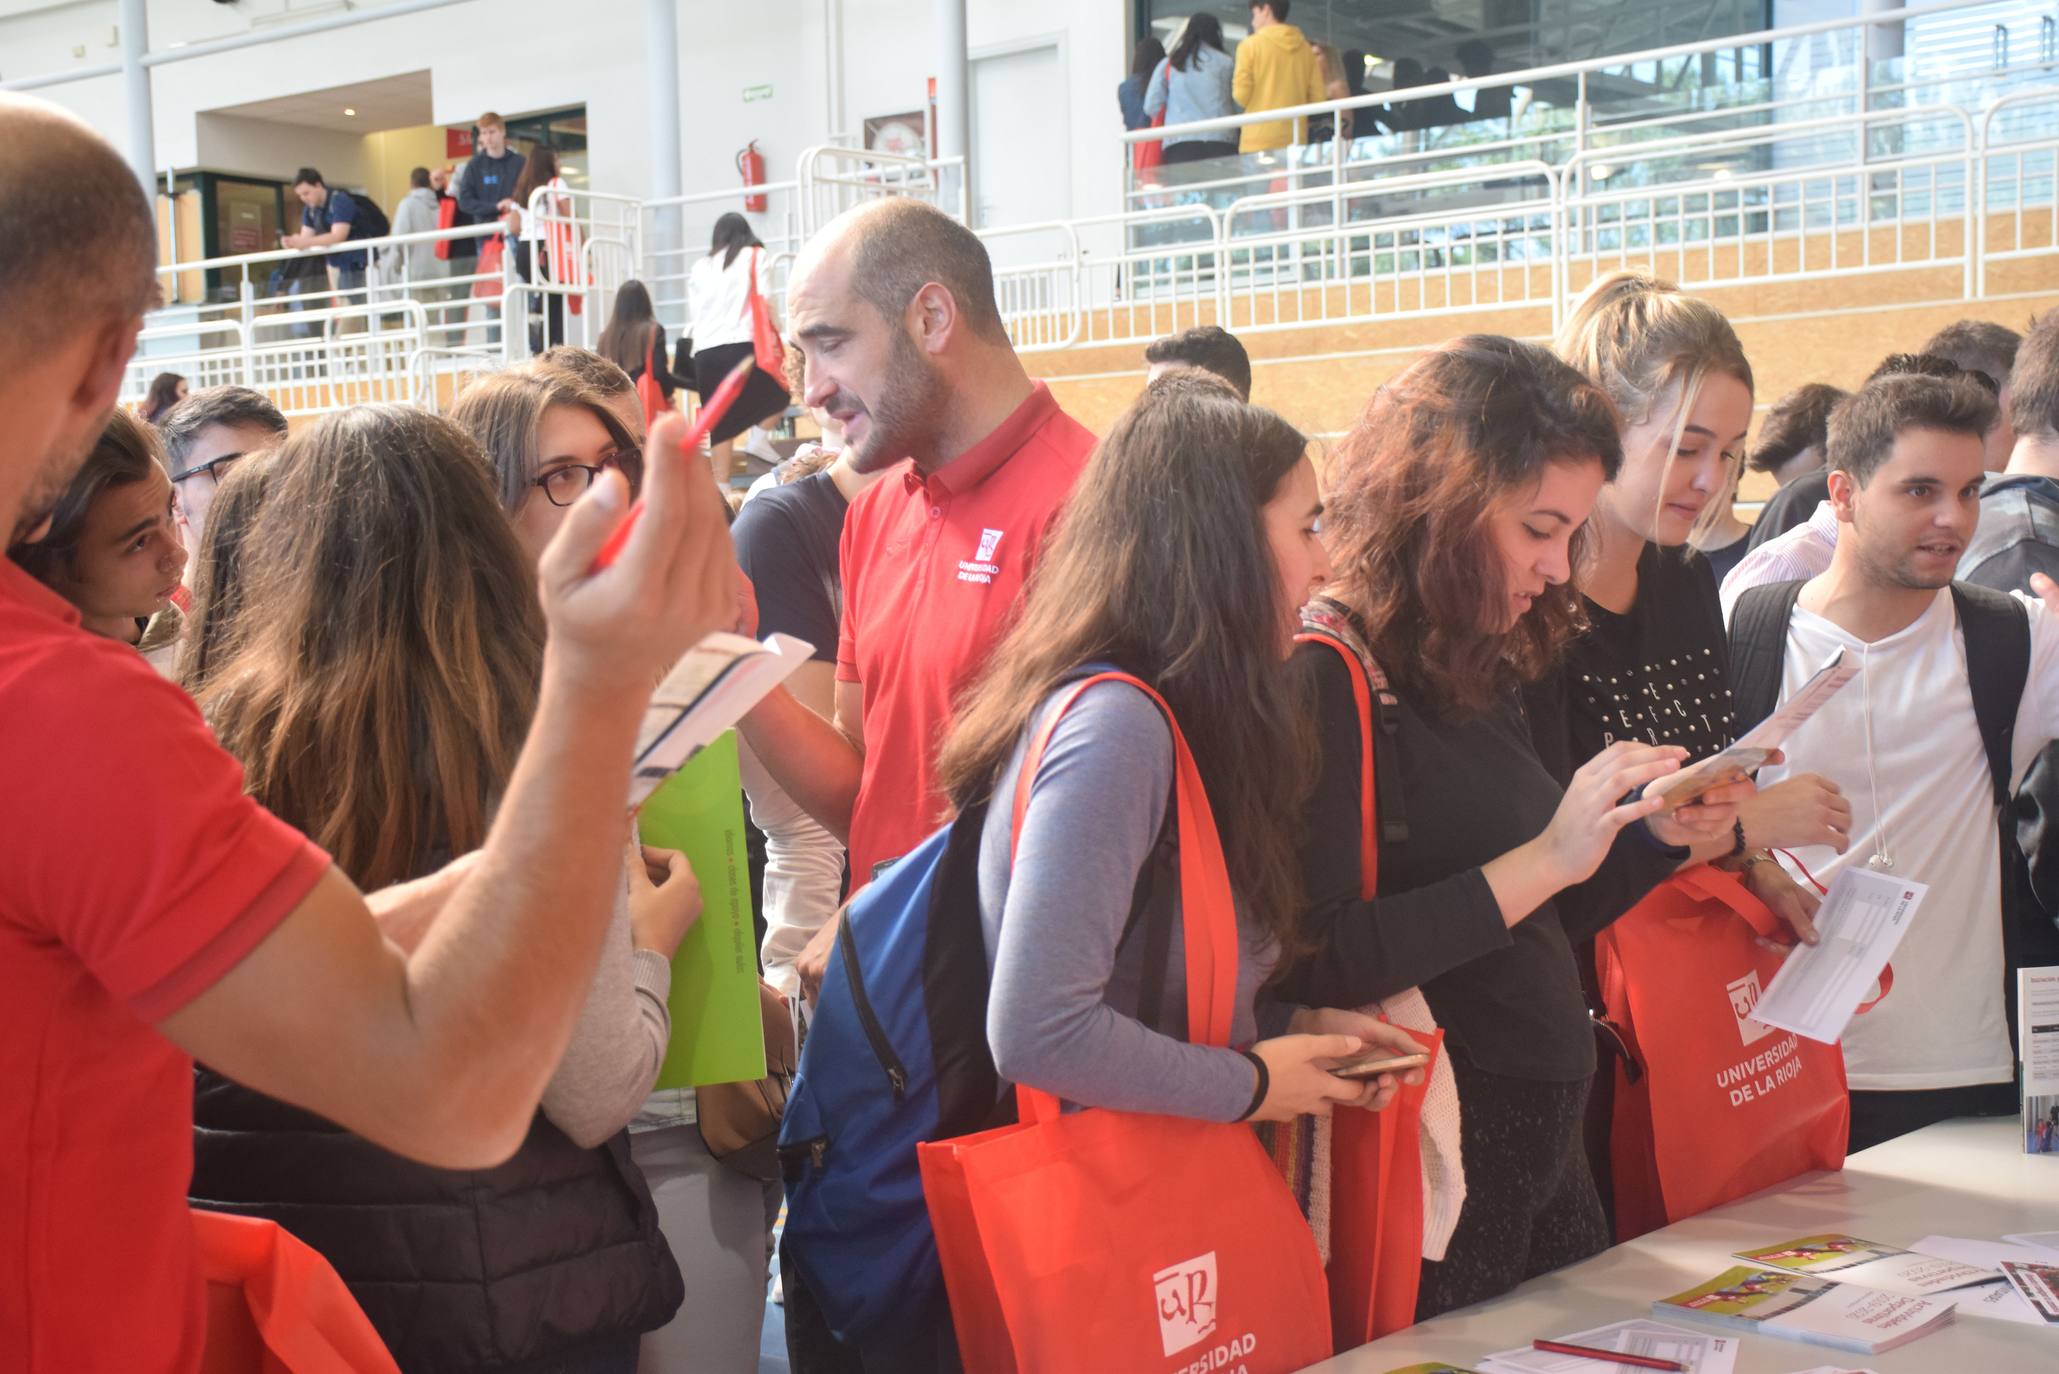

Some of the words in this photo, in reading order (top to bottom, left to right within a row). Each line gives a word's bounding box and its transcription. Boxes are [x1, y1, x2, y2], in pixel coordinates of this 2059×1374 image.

[1716, 1033, 1798, 1088] UNIVERSIDAD
[1730, 1084, 1754, 1106] DE
[1755, 1075, 1776, 1096] LA
[1776, 1056, 1803, 1086] RIOJA
